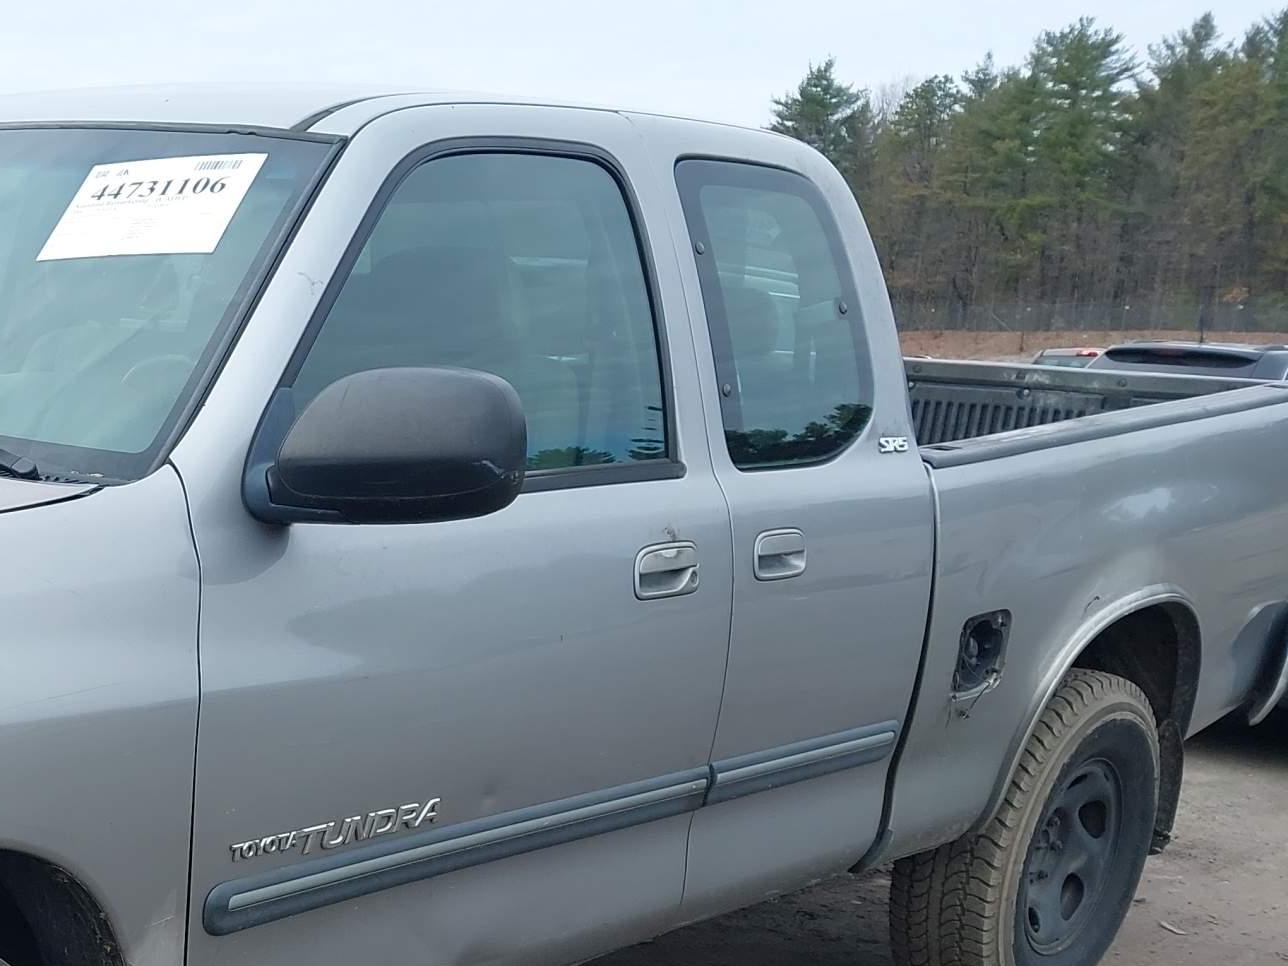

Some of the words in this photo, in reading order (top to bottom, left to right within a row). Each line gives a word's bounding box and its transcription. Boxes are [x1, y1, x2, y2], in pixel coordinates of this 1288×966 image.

[90, 175, 231, 201] 44731106
[878, 436, 909, 453] SR5
[230, 831, 296, 862] TOYOTA
[296, 797, 441, 855] TUNDRA
